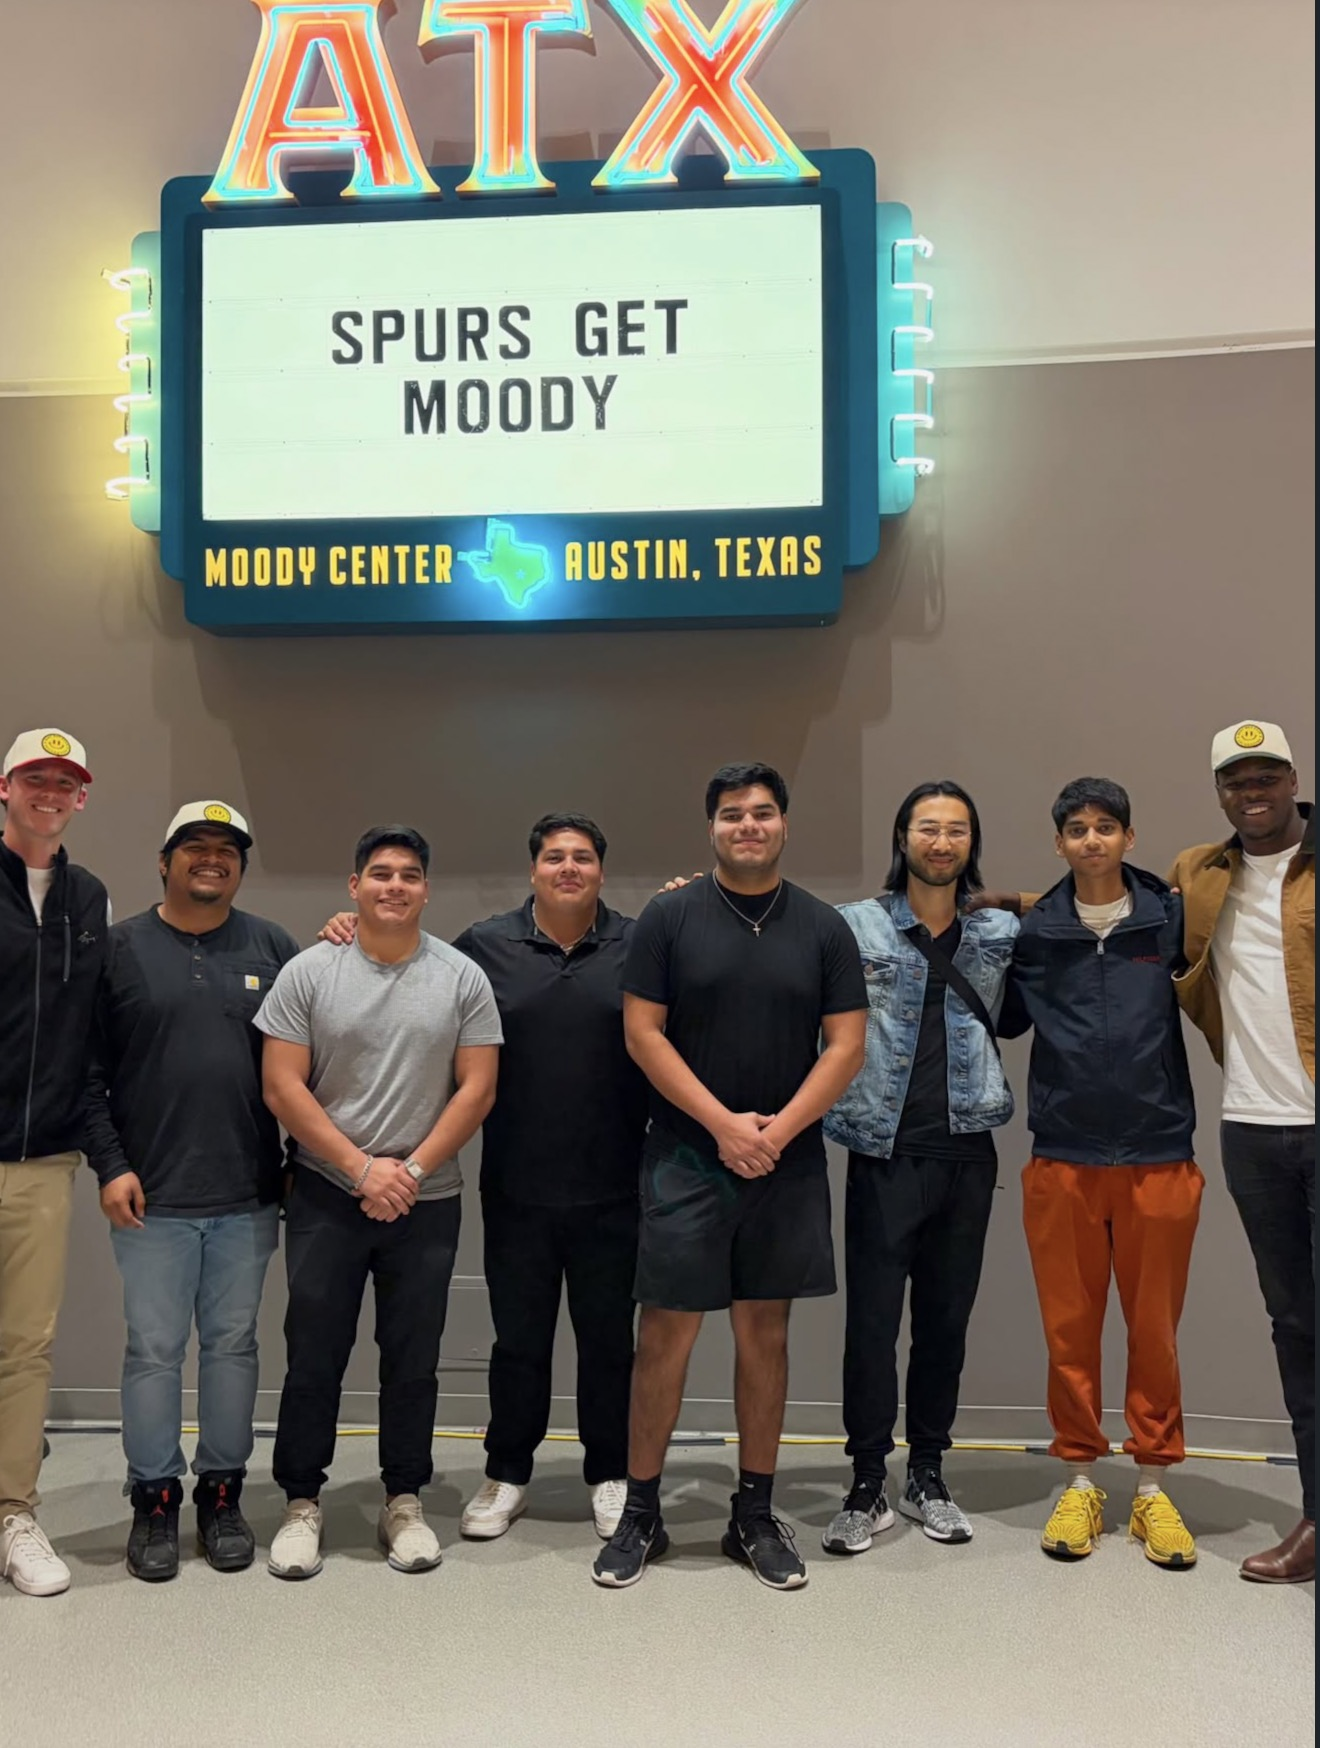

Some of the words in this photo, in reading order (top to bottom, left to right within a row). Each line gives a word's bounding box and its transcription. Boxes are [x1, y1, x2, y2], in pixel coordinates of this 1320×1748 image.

[201, 0, 821, 202] ATX
[331, 304, 531, 365] SPURS
[575, 299, 688, 358] GET
[403, 374, 619, 435] MOODY
[205, 546, 316, 587] MOODY
[329, 544, 452, 585] CENTER
[565, 538, 701, 582] AUSTIN,
[714, 535, 822, 578] TEXAS
